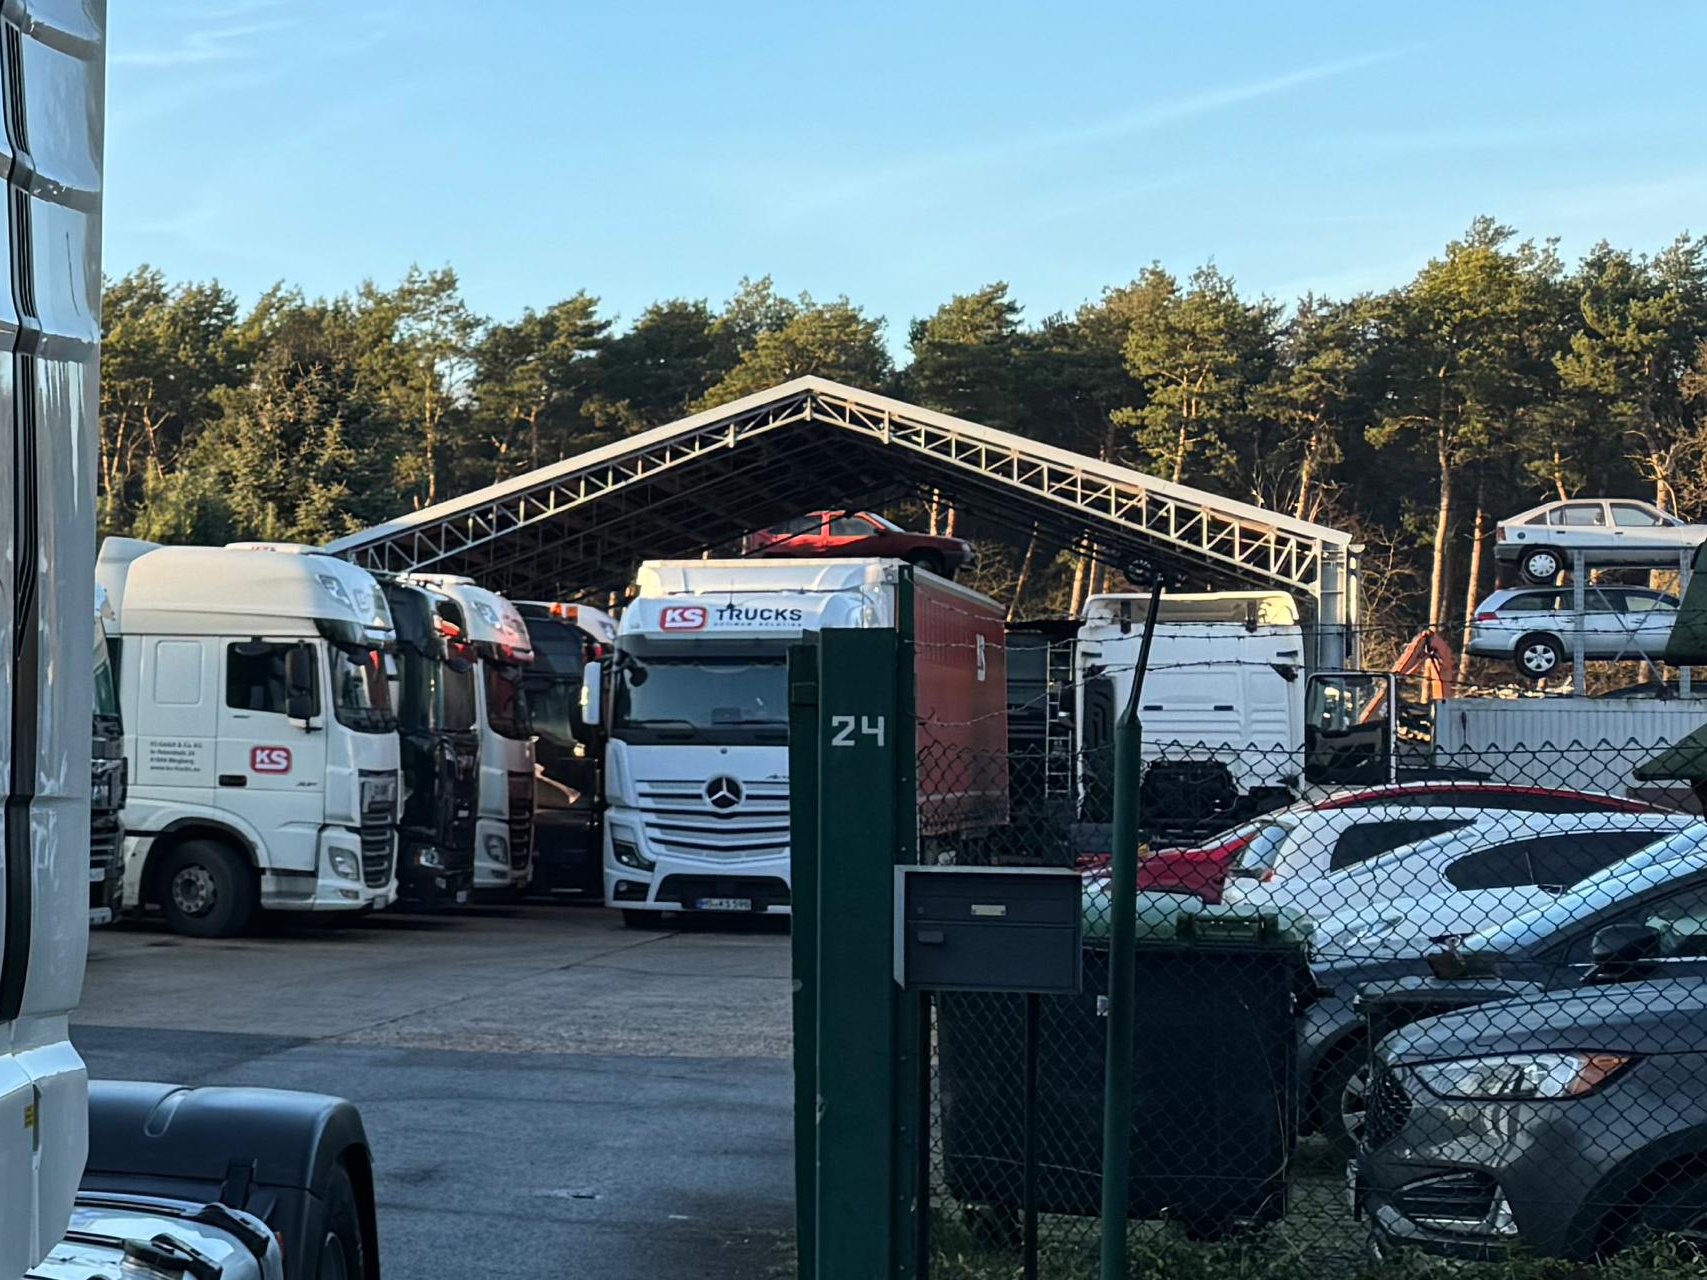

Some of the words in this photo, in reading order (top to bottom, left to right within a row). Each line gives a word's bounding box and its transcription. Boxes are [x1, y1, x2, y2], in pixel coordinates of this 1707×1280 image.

[666, 608, 704, 628] KS
[716, 608, 803, 621] TRUCKS
[831, 715, 885, 747] 24
[255, 750, 287, 770] KS
